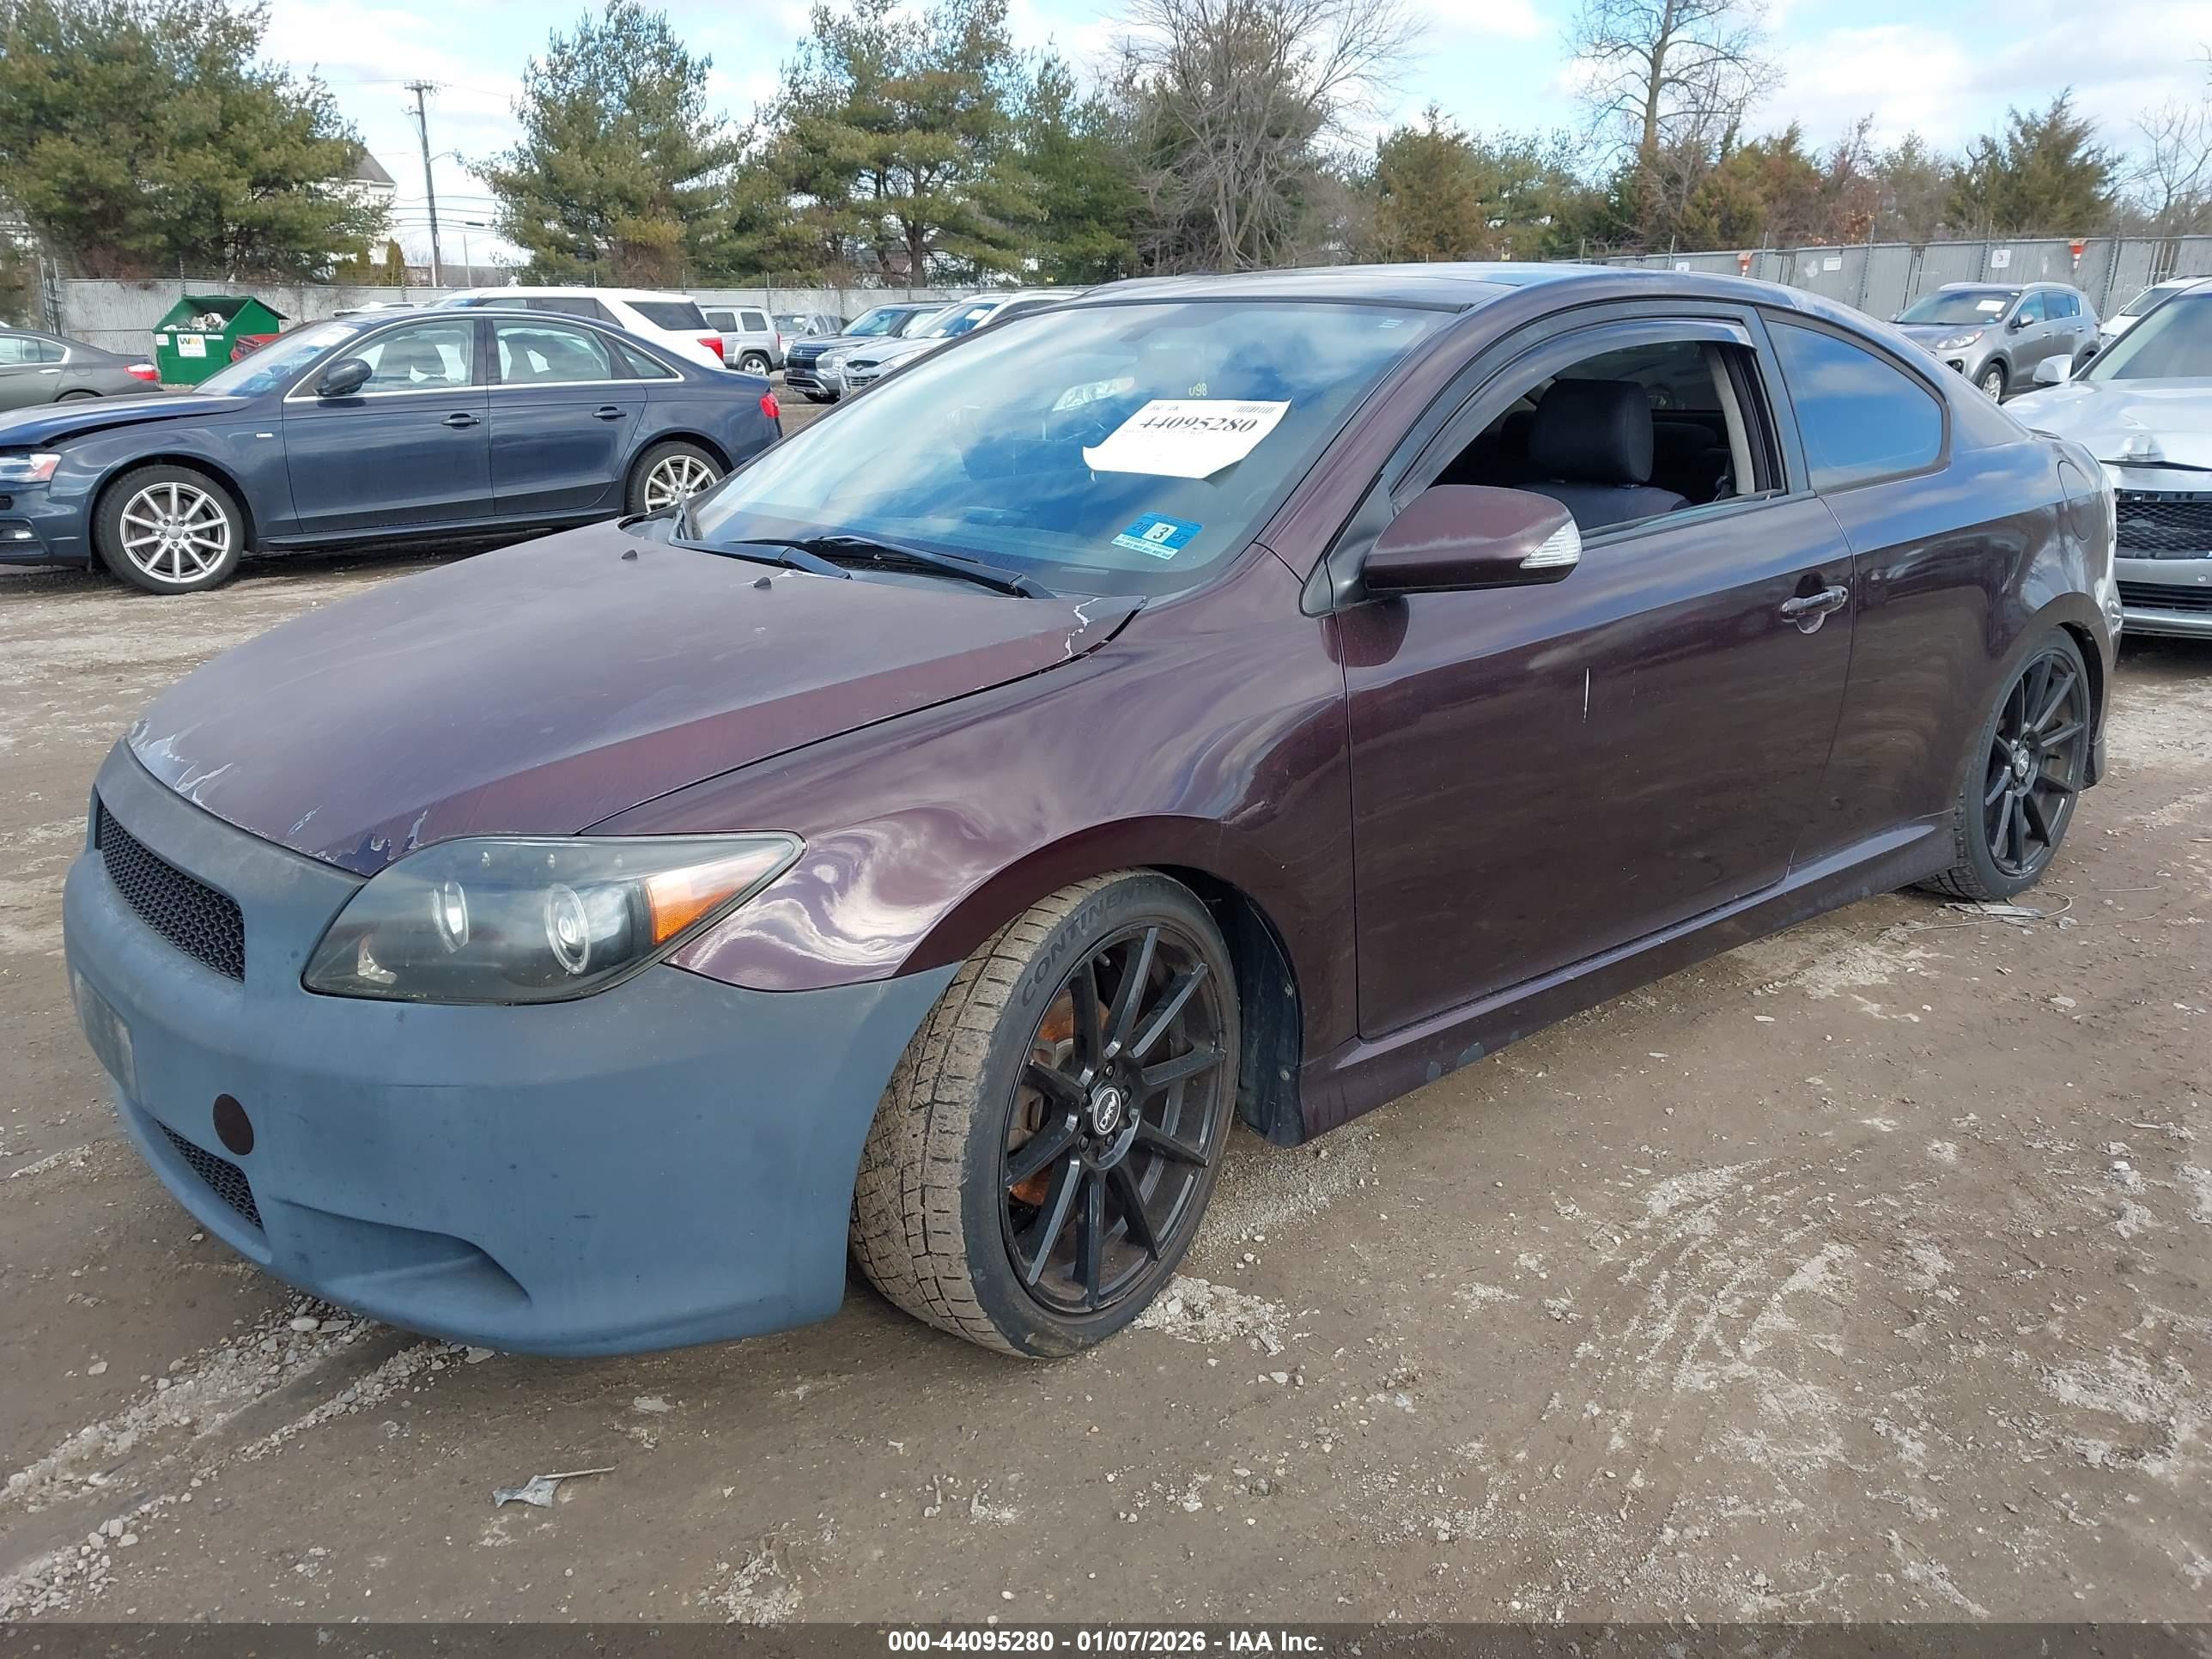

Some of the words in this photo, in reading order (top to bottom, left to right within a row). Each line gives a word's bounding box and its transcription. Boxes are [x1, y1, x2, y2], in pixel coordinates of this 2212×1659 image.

[179, 337, 202, 346] WM
[1139, 416, 1259, 433] 44095280
[1133, 521, 1150, 532] 20
[1152, 526, 1170, 539] 3
[1170, 532, 1189, 543] 27
